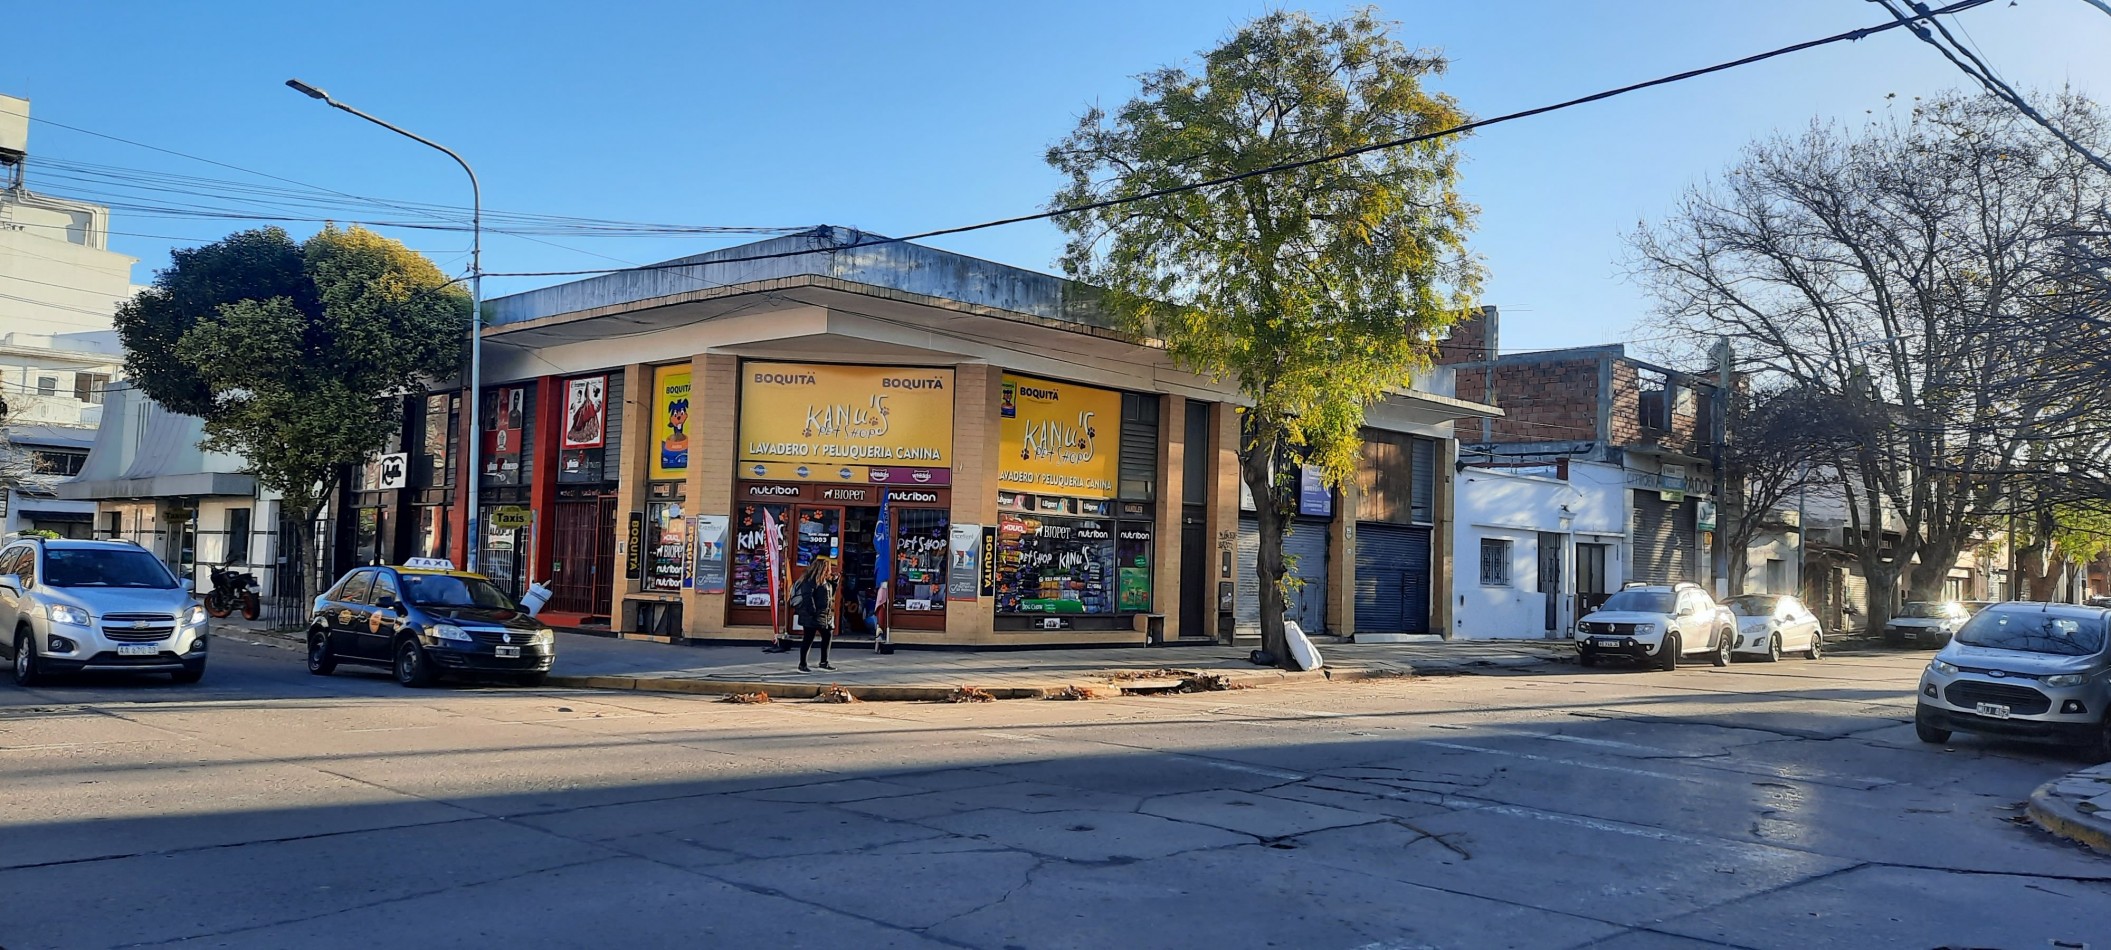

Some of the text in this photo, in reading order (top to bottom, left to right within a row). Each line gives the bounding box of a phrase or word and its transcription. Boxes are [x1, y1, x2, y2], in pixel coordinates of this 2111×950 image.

[749, 442, 941, 461] LAVADERO Y PELUQUERIA CANINA
[1035, 473, 1042, 483] Y
[1042, 474, 1085, 489] PELUQUERIA
[1086, 477, 1113, 491] CANINA
[750, 485, 799, 496] nutribon
[887, 491, 937, 502] nutribon
[497, 513, 525, 523] Taxis
[1078, 530, 1108, 538] nutribon
[1120, 531, 1150, 540] nutribon
[413, 558, 449, 567] TAXI
